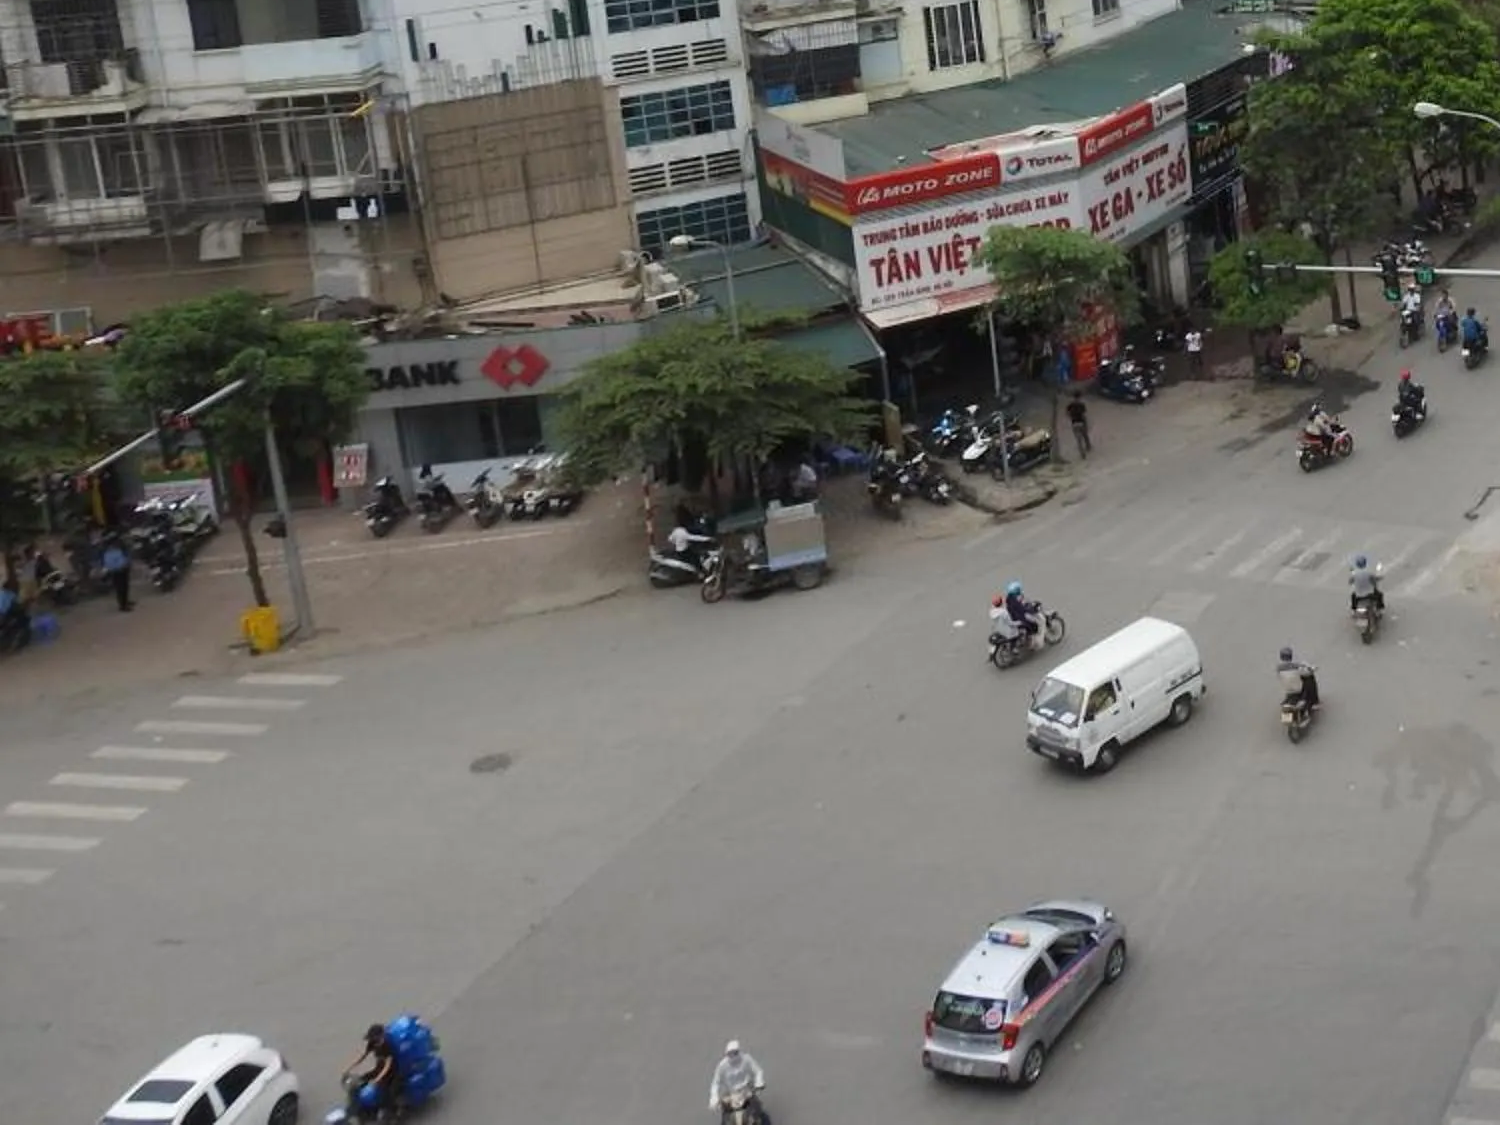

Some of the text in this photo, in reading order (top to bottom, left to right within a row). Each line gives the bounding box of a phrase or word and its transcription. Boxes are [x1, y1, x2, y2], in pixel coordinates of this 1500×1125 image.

[1026, 153, 1073, 169] TOTAL
[883, 166, 994, 201] MOTO ZONE
[1088, 199, 1111, 235] XE
[1111, 186, 1135, 222] GA
[1146, 168, 1166, 203] XE
[1168, 143, 1188, 190] SỐ
[864, 228, 897, 246] TRUNG
[869, 233, 982, 288] TÂN VIỆT
[365, 359, 462, 391] BANK
